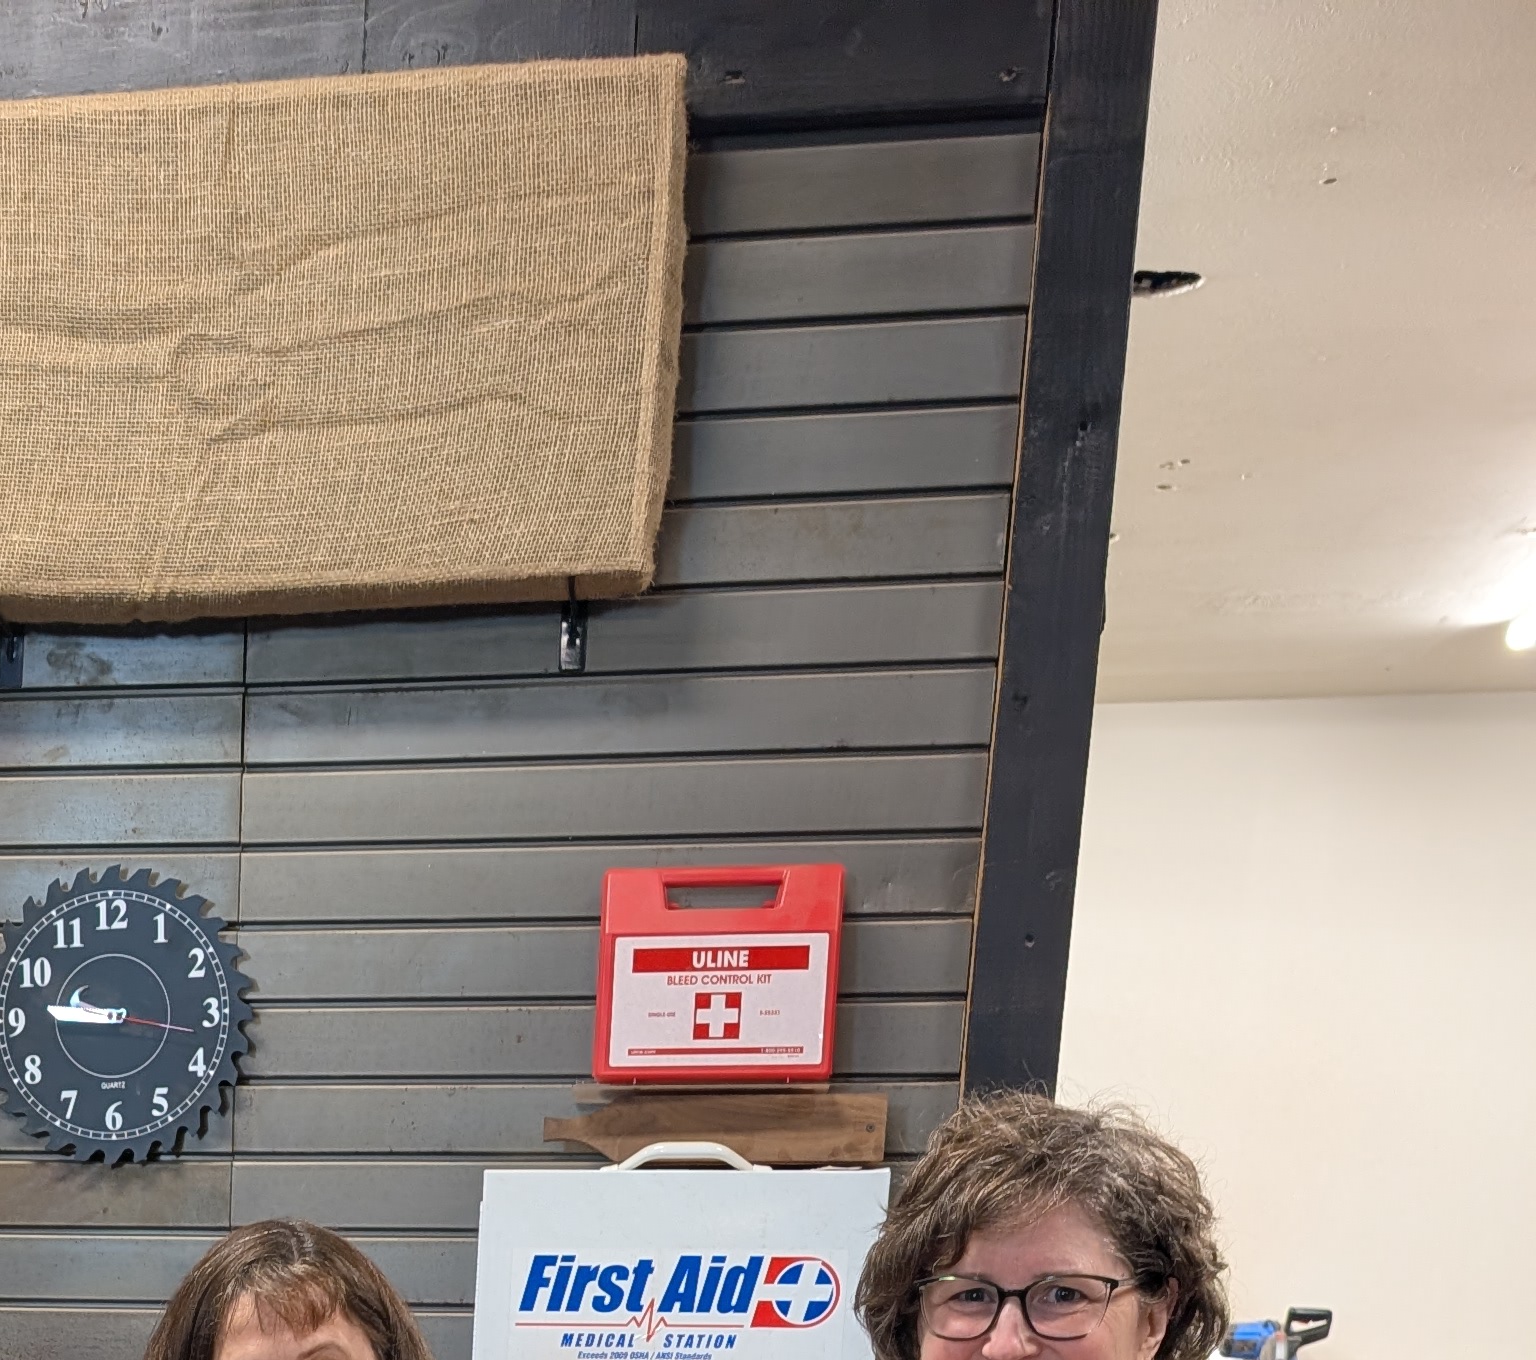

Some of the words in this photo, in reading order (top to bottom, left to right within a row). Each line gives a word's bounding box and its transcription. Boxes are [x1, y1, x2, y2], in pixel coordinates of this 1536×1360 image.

[95, 899, 129, 930] 12
[153, 913, 168, 944] 1
[53, 917, 84, 949] 11
[19, 957, 52, 988] 10
[187, 947, 206, 978] 2
[692, 950, 750, 968] ULINE
[667, 975, 698, 986] BLEED
[701, 974, 754, 985] CONTROL
[756, 974, 772, 984] KIT
[8, 1007, 26, 1038] 9
[202, 997, 220, 1028] 3
[24, 1055, 42, 1085] 8
[188, 1047, 206, 1077] 4
[60, 1089, 78, 1120] 7
[105, 1101, 123, 1131] 6
[151, 1087, 169, 1117] 5
[518, 1254, 654, 1313] First
[656, 1255, 764, 1314] Aid
[560, 1333, 635, 1348] MEDICAL
[663, 1333, 737, 1349] STATION
[577, 1351, 608, 1360] Exceeds
[674, 1352, 712, 1360] Standards
